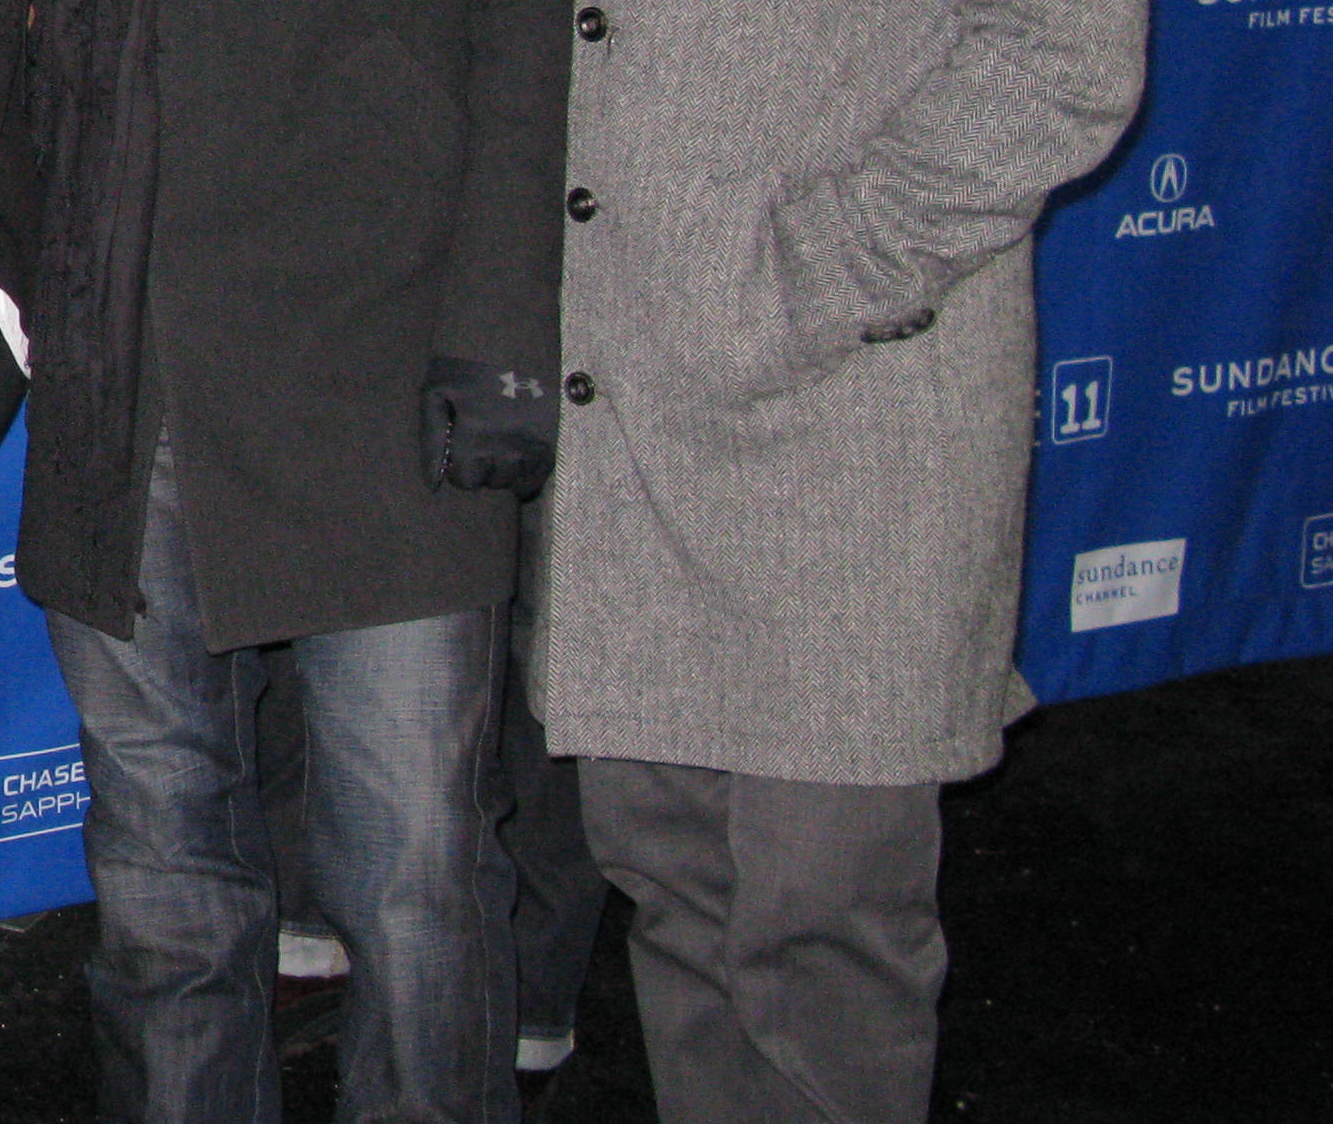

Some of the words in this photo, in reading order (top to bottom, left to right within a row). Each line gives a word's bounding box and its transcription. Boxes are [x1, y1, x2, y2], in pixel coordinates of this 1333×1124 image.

[1248, 9, 1290, 29] FILM
[1115, 205, 1215, 239] ACURA
[1060, 380, 1102, 435] 11
[1227, 395, 1268, 418] FILM
[1077, 554, 1180, 585] sundance
[1076, 585, 1137, 605] CHANNEL
[3, 761, 86, 797] CHASE
